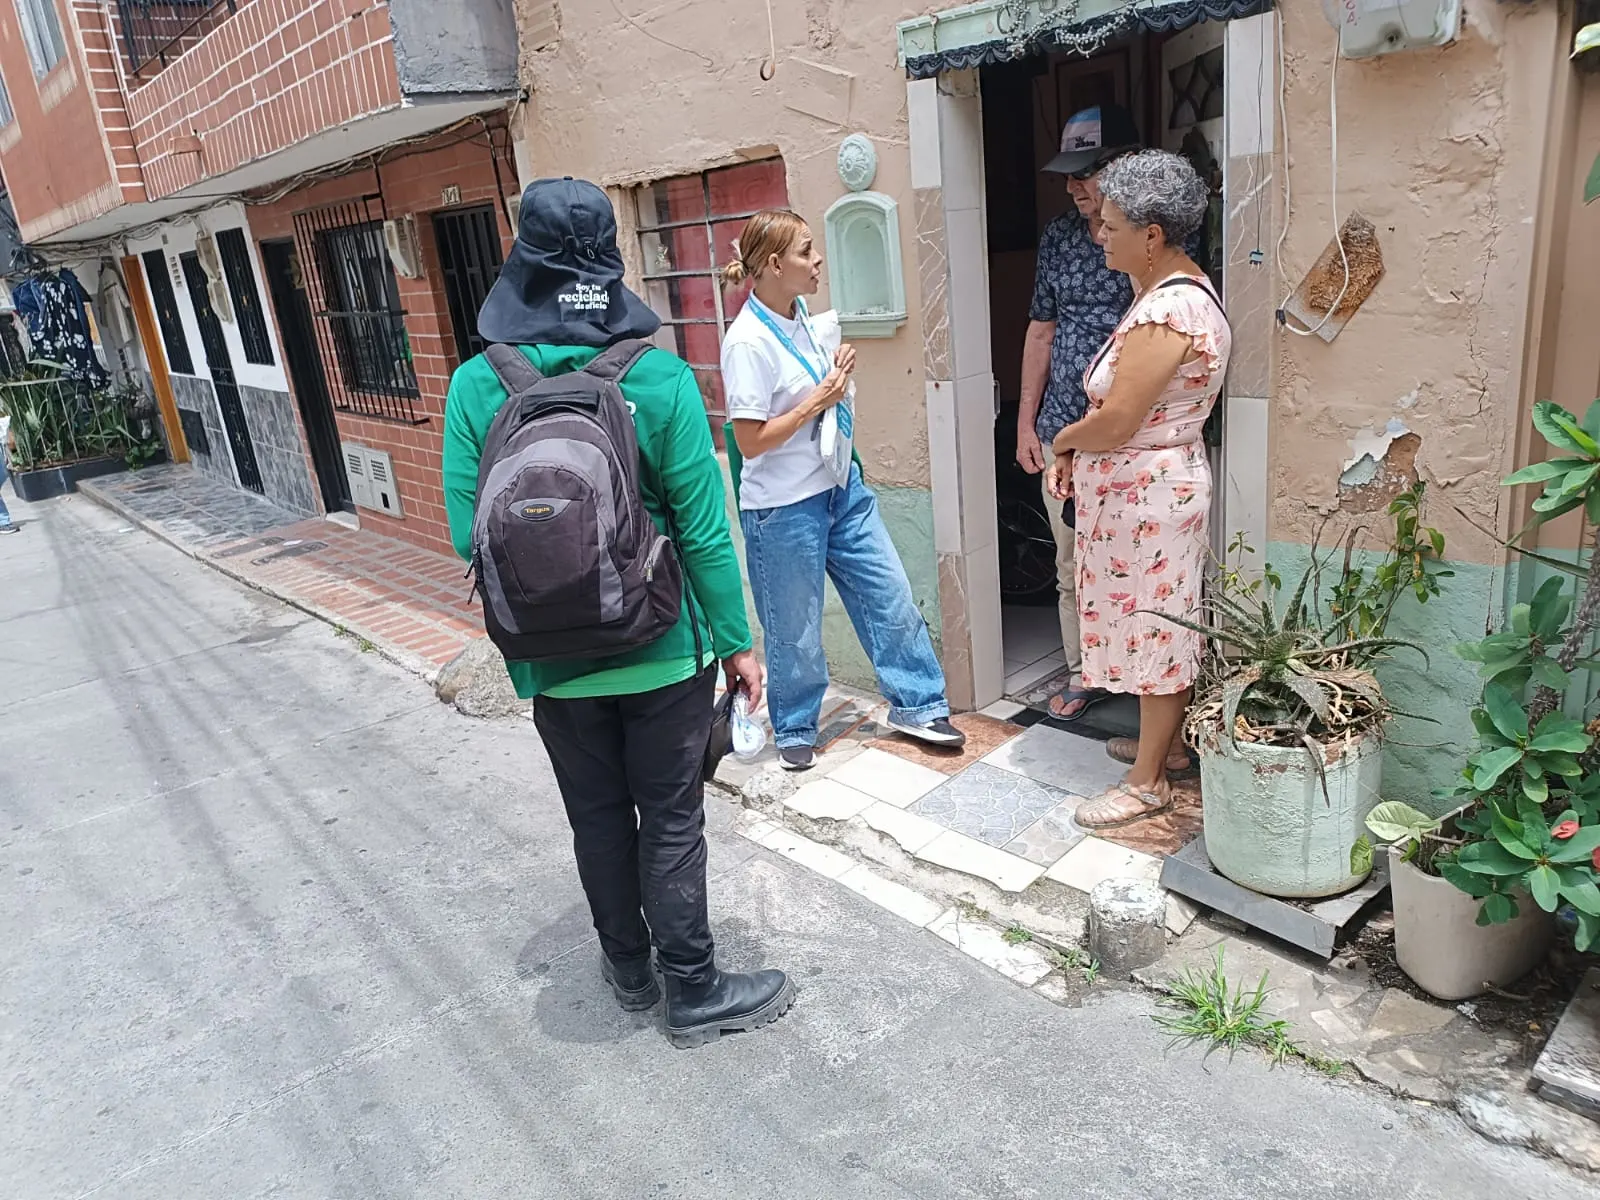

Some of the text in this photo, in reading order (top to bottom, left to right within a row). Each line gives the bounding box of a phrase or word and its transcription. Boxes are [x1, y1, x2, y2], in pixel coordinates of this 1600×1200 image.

[575, 283, 590, 292] Soy
[558, 290, 609, 304] reciclad
[574, 301, 607, 310] de oficio
